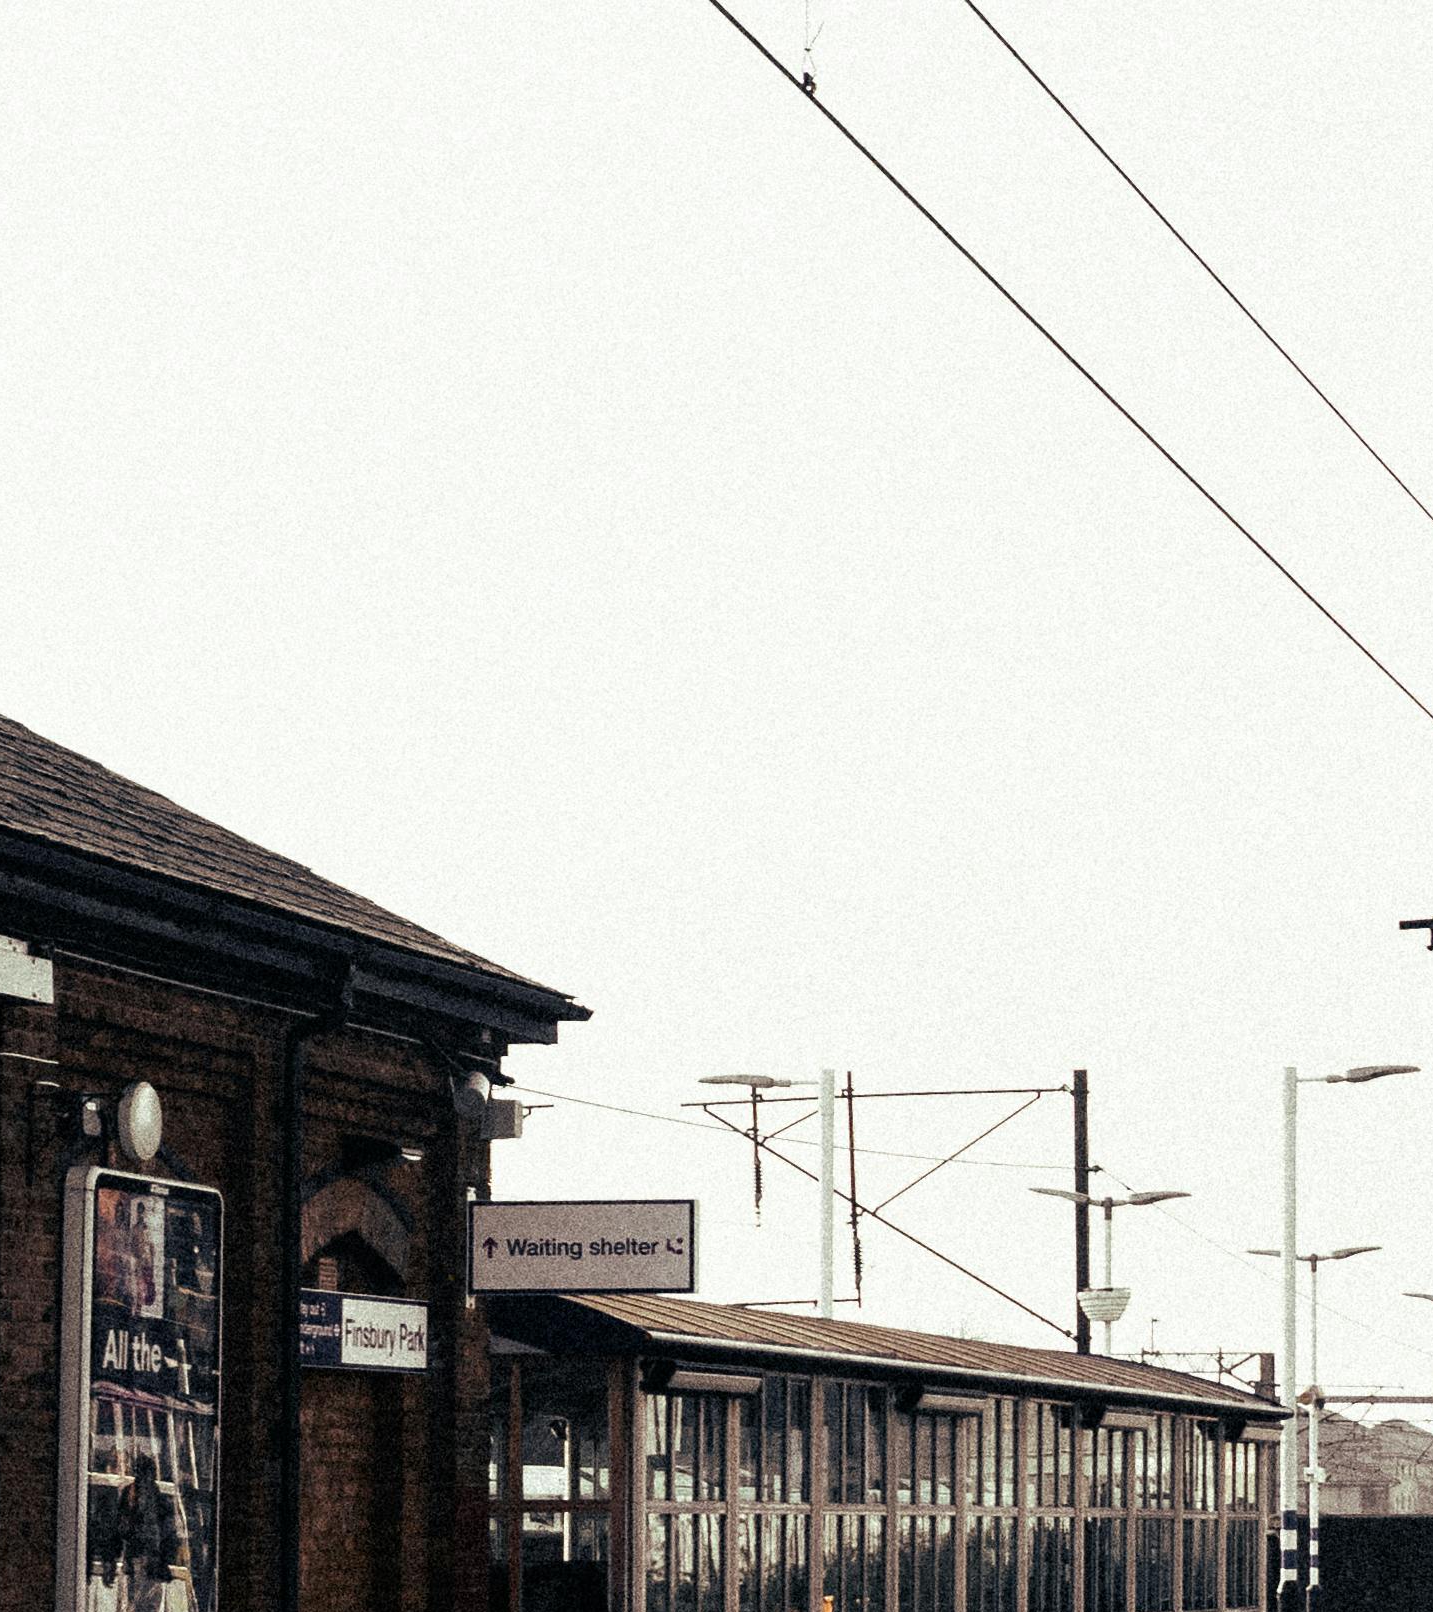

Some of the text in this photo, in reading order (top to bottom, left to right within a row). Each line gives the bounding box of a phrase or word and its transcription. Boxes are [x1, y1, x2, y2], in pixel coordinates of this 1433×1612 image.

[506, 1238, 659, 1260] Waiting shelter
[103, 1328, 162, 1373] All the
[345, 1318, 396, 1357] Finsbury
[400, 1324, 425, 1351] Park
